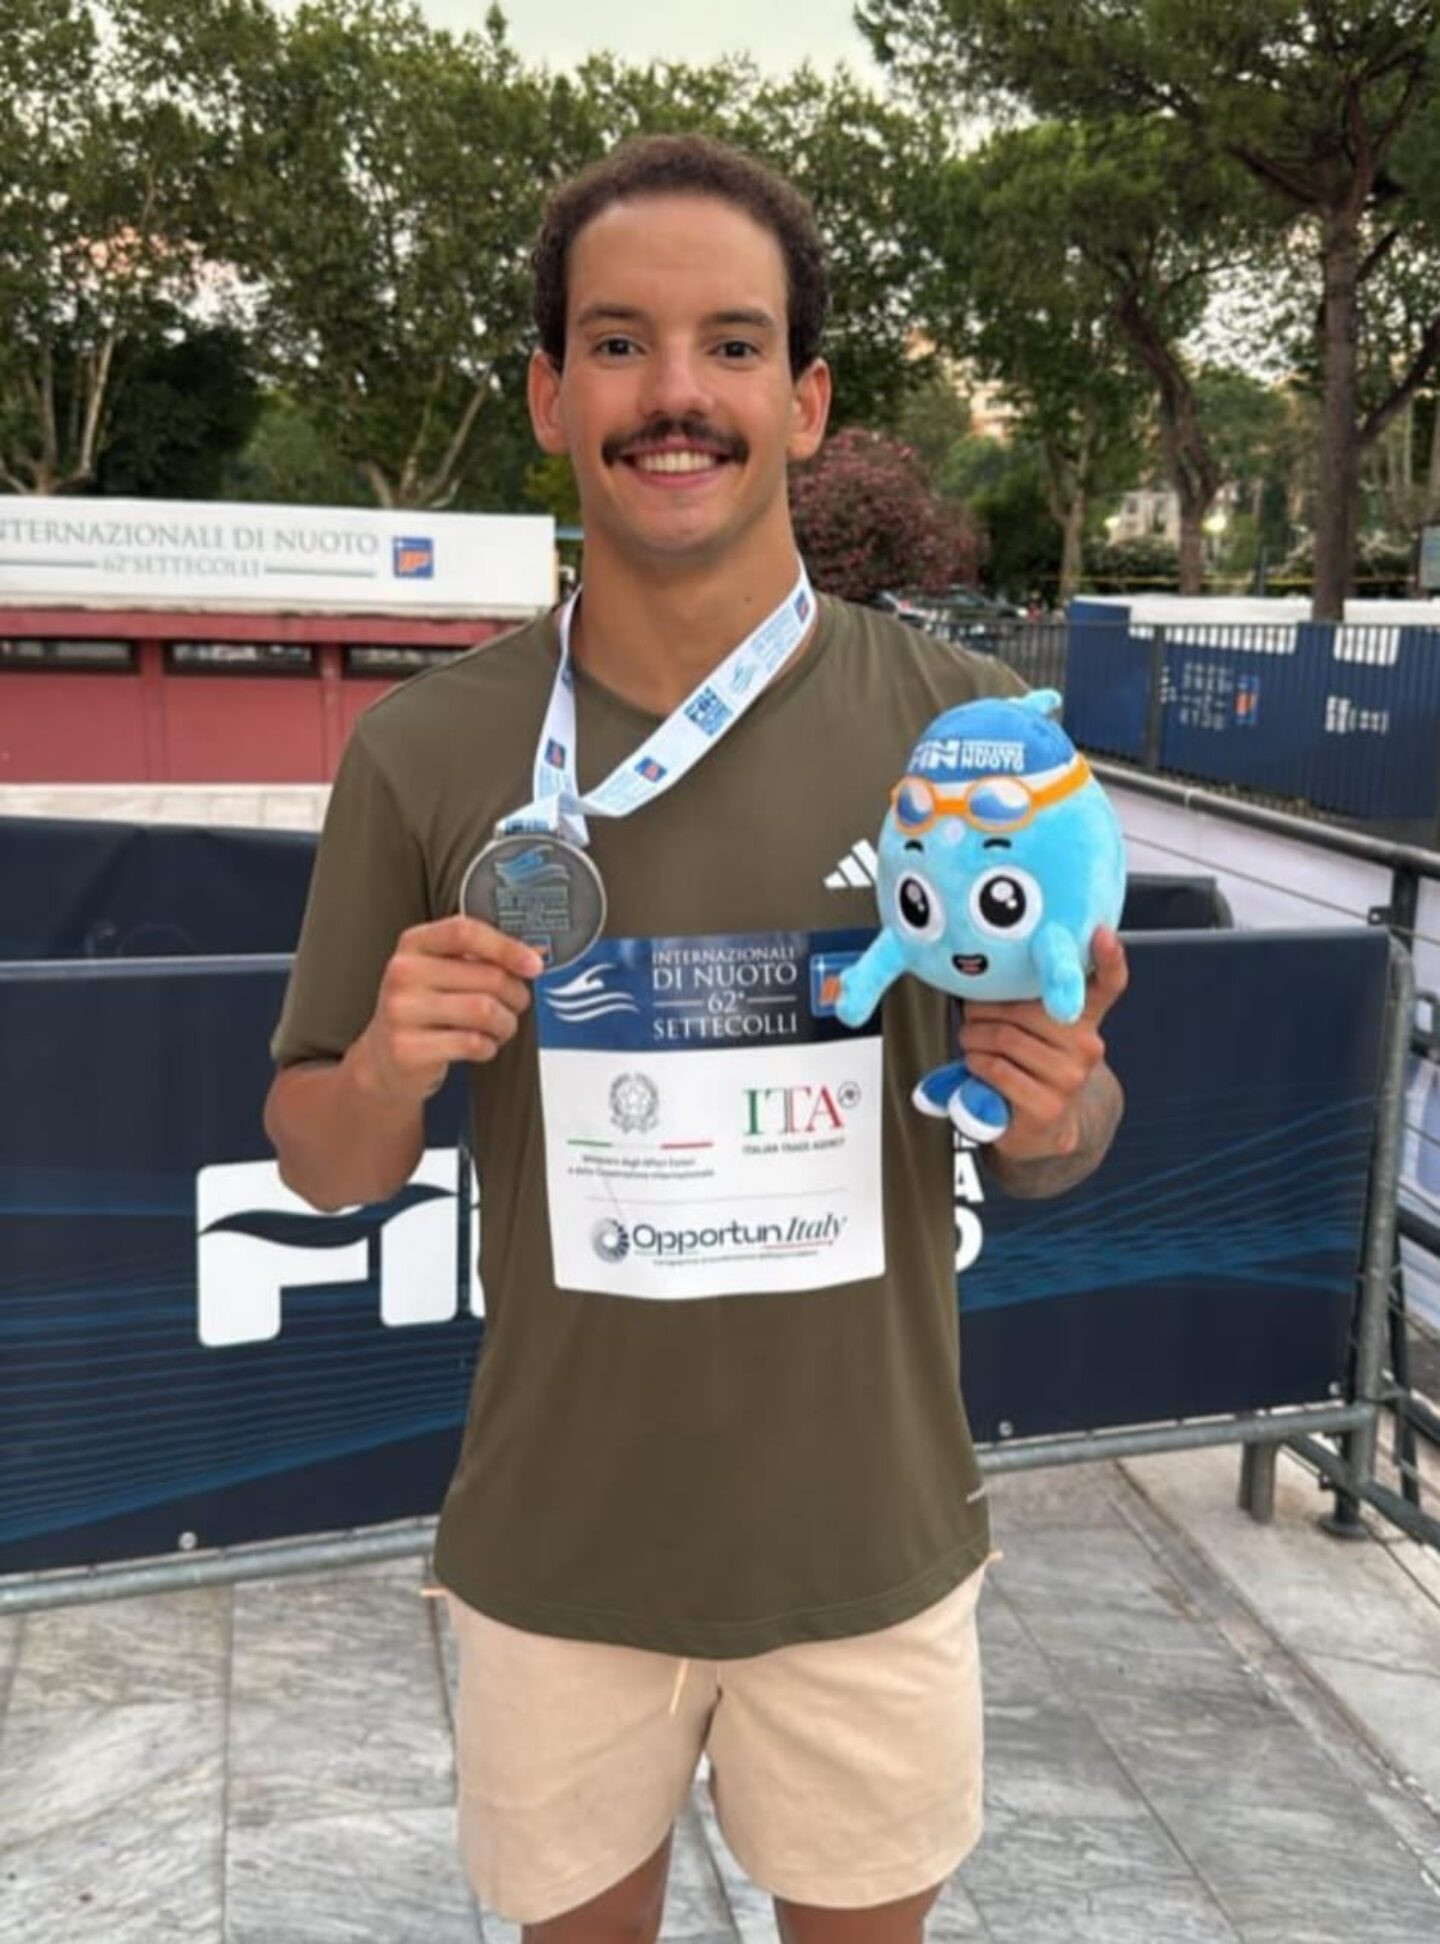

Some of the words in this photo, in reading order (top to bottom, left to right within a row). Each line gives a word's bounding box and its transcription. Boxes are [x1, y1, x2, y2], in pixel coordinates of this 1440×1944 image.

[232, 527, 264, 550] DI
[274, 528, 380, 554] NUOTO
[652, 947, 795, 965] INTERNAZIONALI
[653, 967, 682, 990] DI
[694, 962, 797, 988] NUOTO
[653, 1012, 797, 1040] SETTECOLLI
[742, 1084, 845, 1136] ITA
